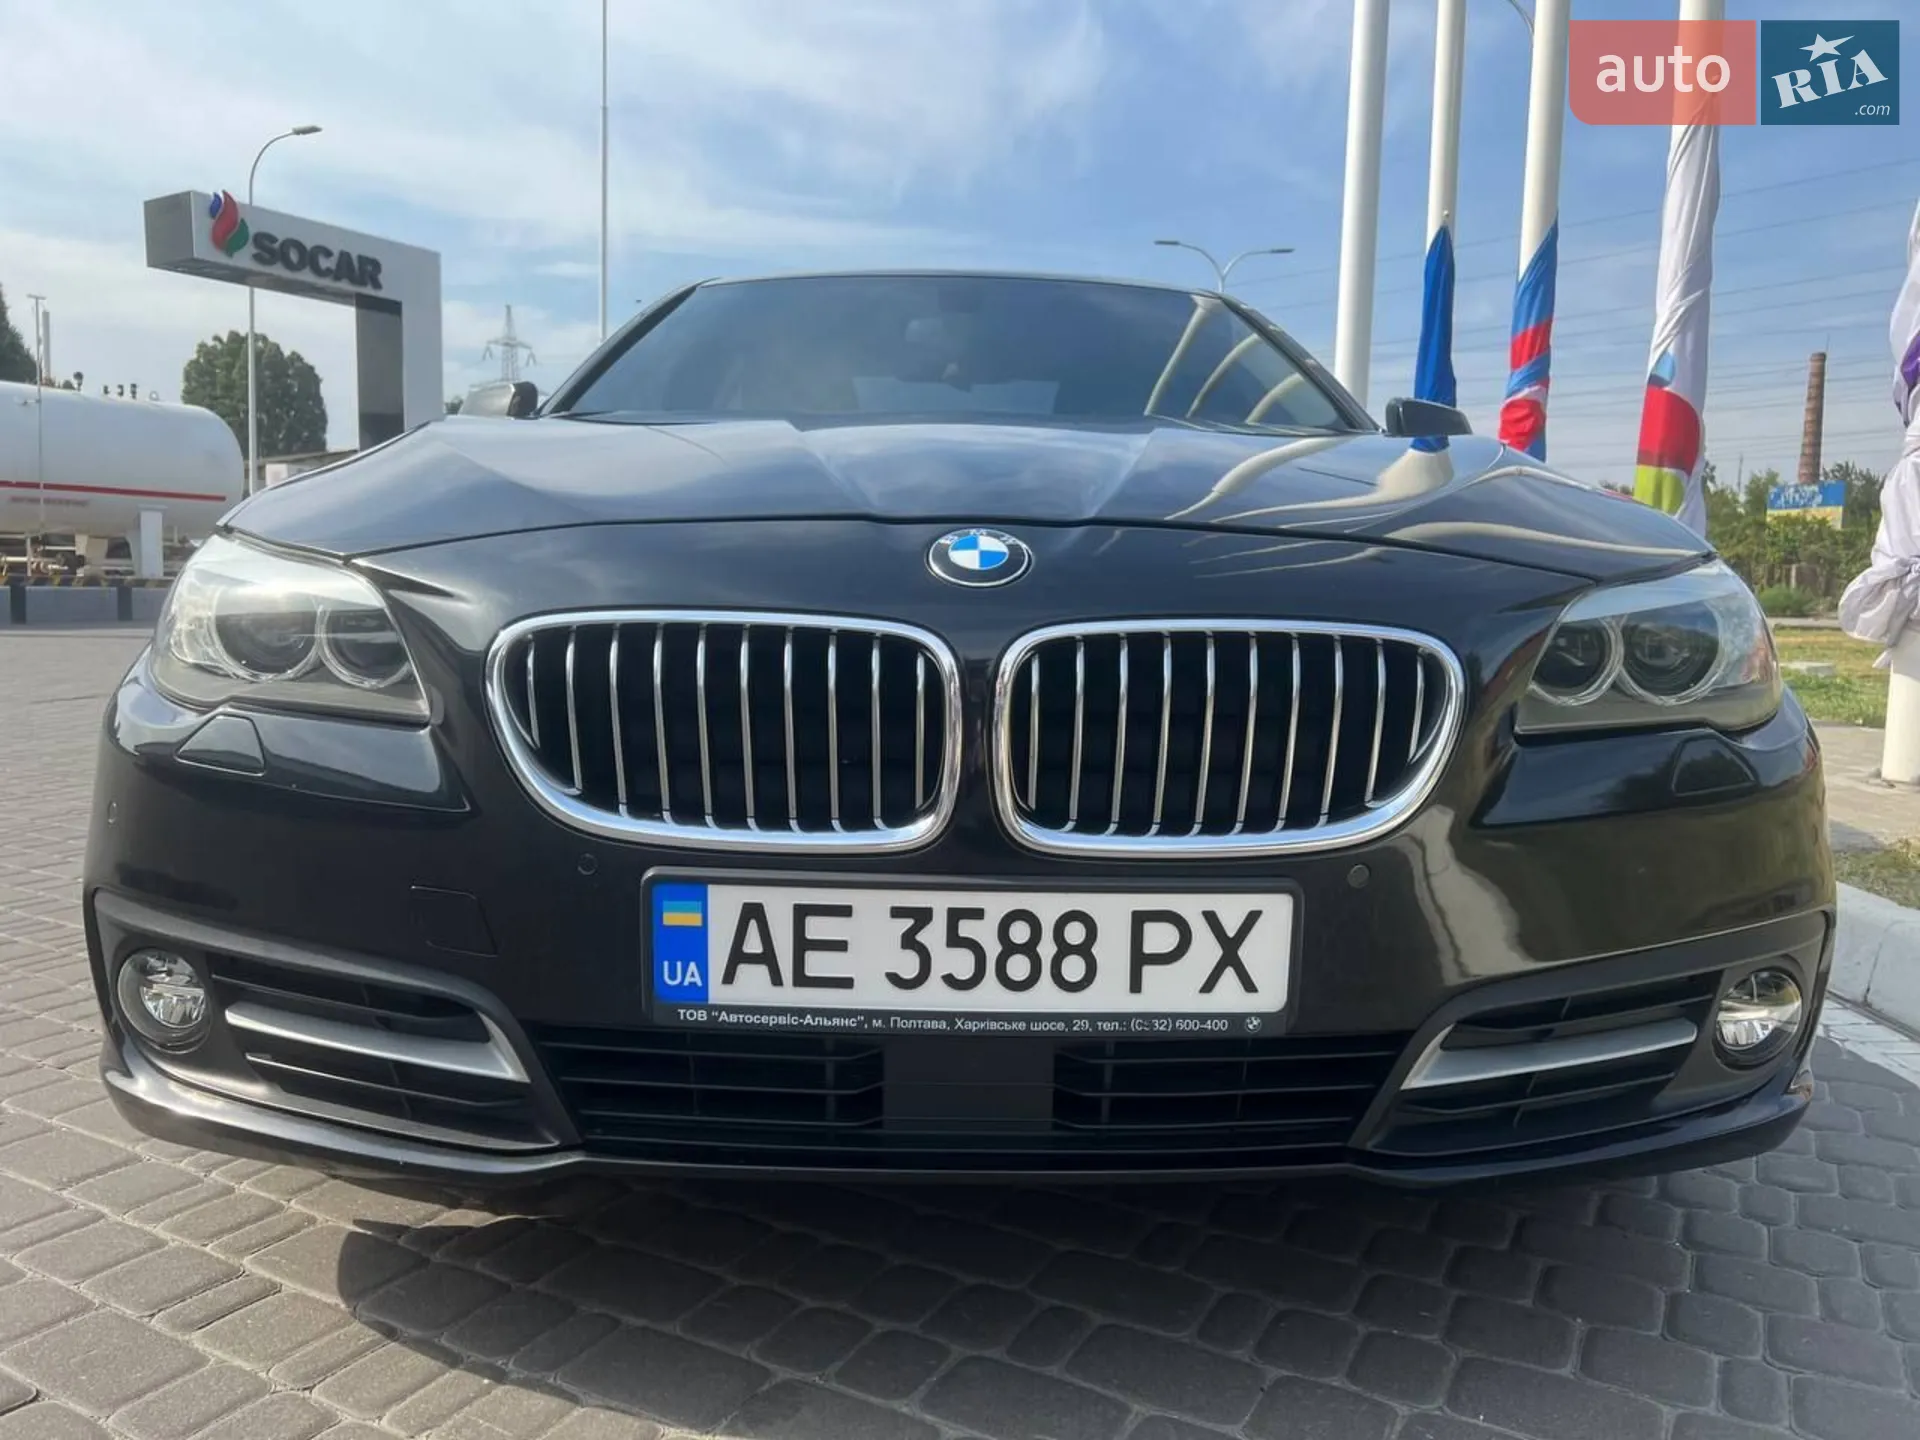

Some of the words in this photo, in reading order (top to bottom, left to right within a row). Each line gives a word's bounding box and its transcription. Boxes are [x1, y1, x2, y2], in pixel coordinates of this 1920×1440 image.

[251, 231, 383, 291] SOCAR
[720, 901, 855, 989] AE
[884, 906, 1099, 994] 3588
[1128, 909, 1265, 994] PX
[662, 961, 703, 987] UA
[677, 1008, 708, 1021] ТОВ
[890, 1017, 951, 1031] Полтава,
[953, 1018, 1026, 1032] Харківське
[1030, 1021, 1068, 1033] шосе,
[1072, 1020, 1093, 1033] 29,
[1175, 1018, 1229, 1031] 600-400
